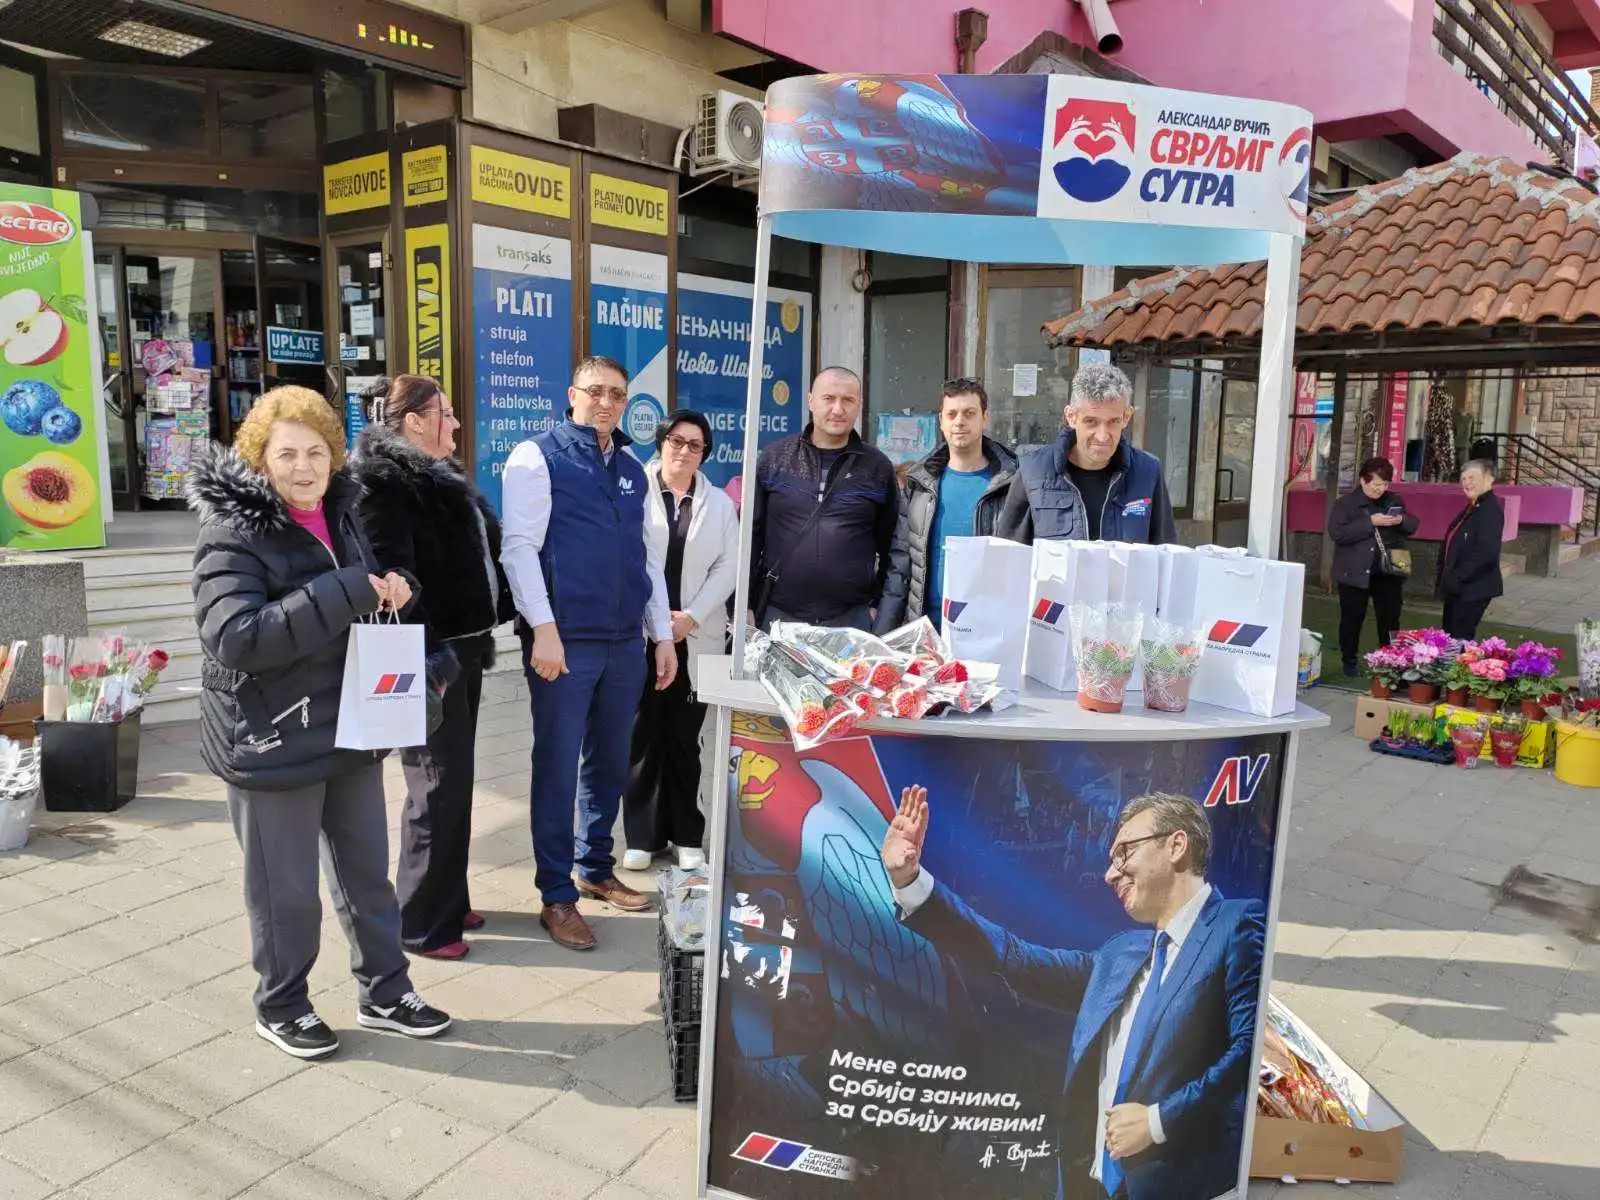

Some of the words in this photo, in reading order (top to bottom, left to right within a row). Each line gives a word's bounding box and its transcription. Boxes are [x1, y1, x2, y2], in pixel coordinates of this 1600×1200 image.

[1157, 110, 1232, 131] АЛЕКСАНДАР
[1233, 118, 1271, 136] ВУЧИЋ
[1150, 128, 1274, 173] СВРЉИГ
[479, 163, 514, 179] UPLATA
[354, 168, 387, 195] OVDE
[515, 171, 563, 202] OVDE
[1139, 167, 1235, 207] СУТРА
[329, 184, 354, 200] NOVCA
[594, 188, 624, 203] PLATNI
[594, 199, 624, 214] PROMET
[625, 196, 665, 222] OVDE
[496, 245, 552, 265] transaks
[496, 287, 553, 319] PLATI
[597, 297, 664, 331] RAČUNE
[271, 333, 320, 352] UPLATE
[490, 326, 528, 344] struja
[490, 351, 534, 367] telefon
[490, 371, 540, 388] internet
[490, 393, 553, 410] kablovska
[490, 417, 516, 431] rate
[490, 436, 518, 453] taks
[829, 1049, 897, 1075] Мене
[902, 1061, 967, 1080] само
[828, 1074, 916, 1104] Србија
[920, 1087, 1022, 1112] занима,
[825, 1101, 855, 1119] за
[860, 1104, 948, 1133] Србију
[950, 1114, 1046, 1132] живим!
[803, 1157, 850, 1172] НАПРЕДНА
[808, 1151, 843, 1164] СРПСКА
[798, 1163, 838, 1176] СТРАНКА
